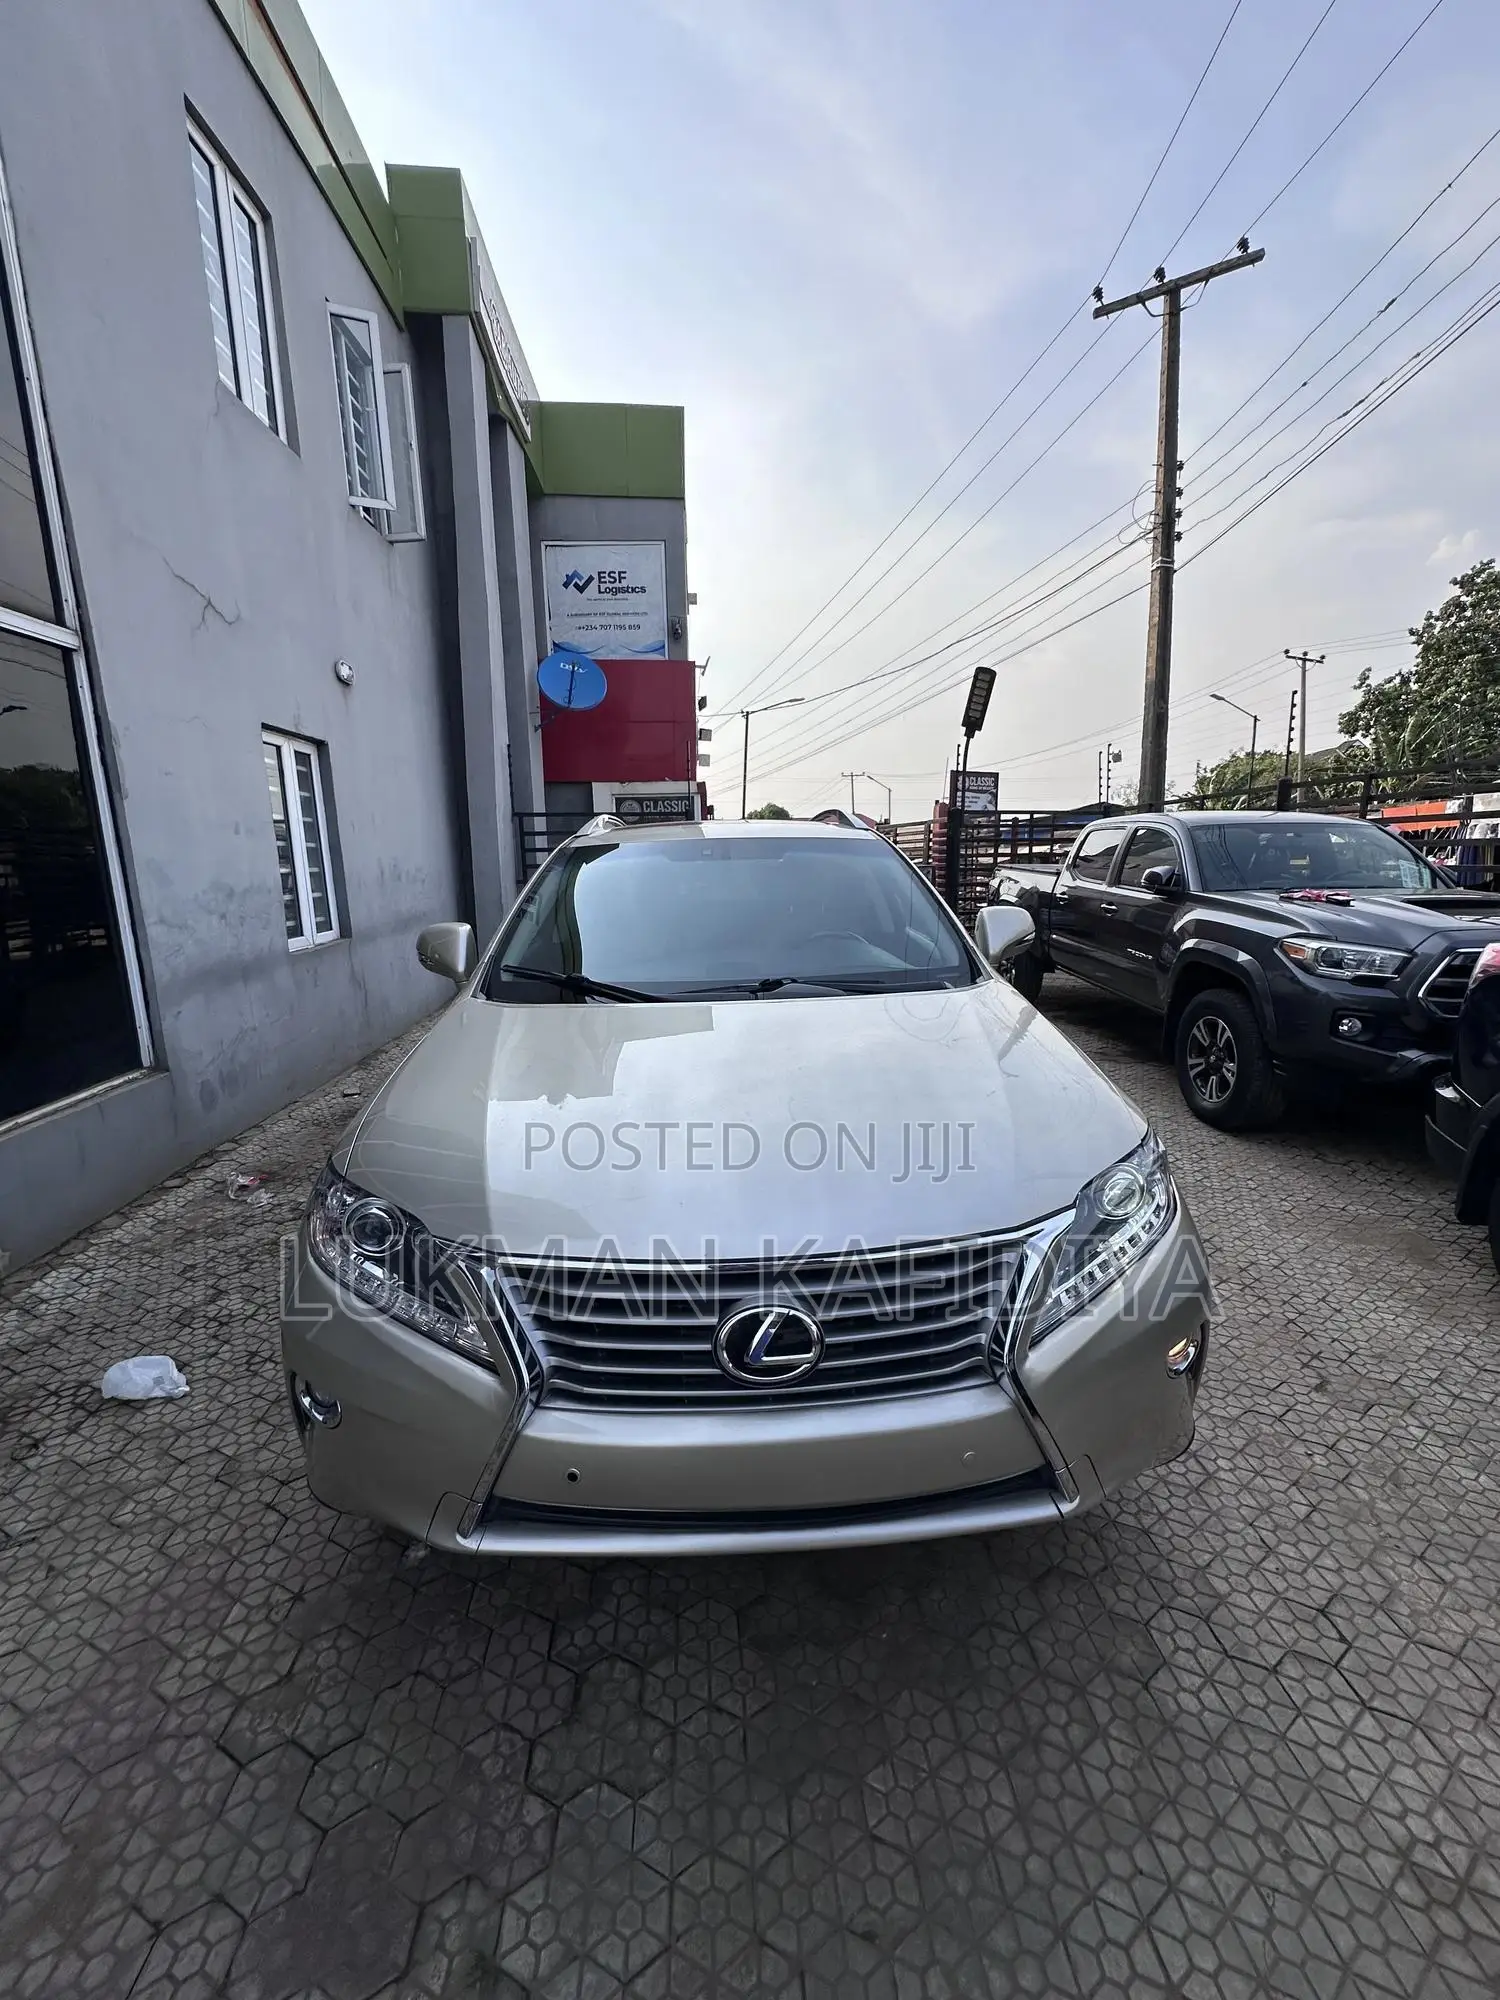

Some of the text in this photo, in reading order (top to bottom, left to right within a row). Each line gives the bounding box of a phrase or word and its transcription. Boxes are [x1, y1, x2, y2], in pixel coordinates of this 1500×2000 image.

[597, 571, 627, 584] ESF
[597, 584, 647, 596] Logistics
[970, 776, 995, 786] CLASSIC
[643, 800, 689, 813] CLASSIC
